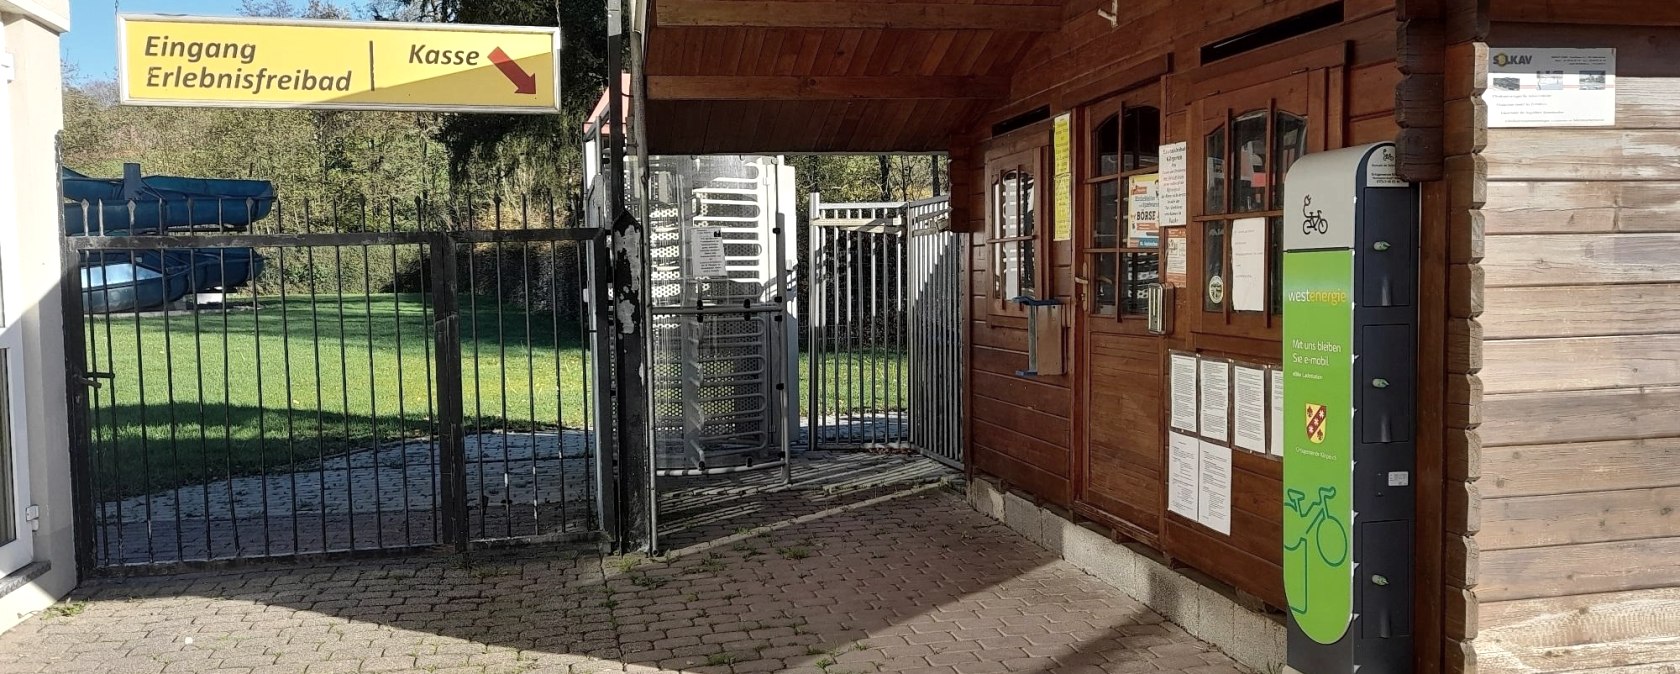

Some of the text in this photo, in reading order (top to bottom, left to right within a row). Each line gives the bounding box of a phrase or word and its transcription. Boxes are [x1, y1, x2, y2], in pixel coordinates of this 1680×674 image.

[144, 35, 256, 64] Eingang
[408, 44, 480, 66] Kasse
[1493, 53, 1532, 67] SOLKAV
[146, 66, 352, 94] Erlebnisfreibad
[1288, 288, 1347, 305] westenergie
[1292, 339, 1342, 353] Mit uns bleiben
[1292, 352, 1329, 366] Sie e-mobil
